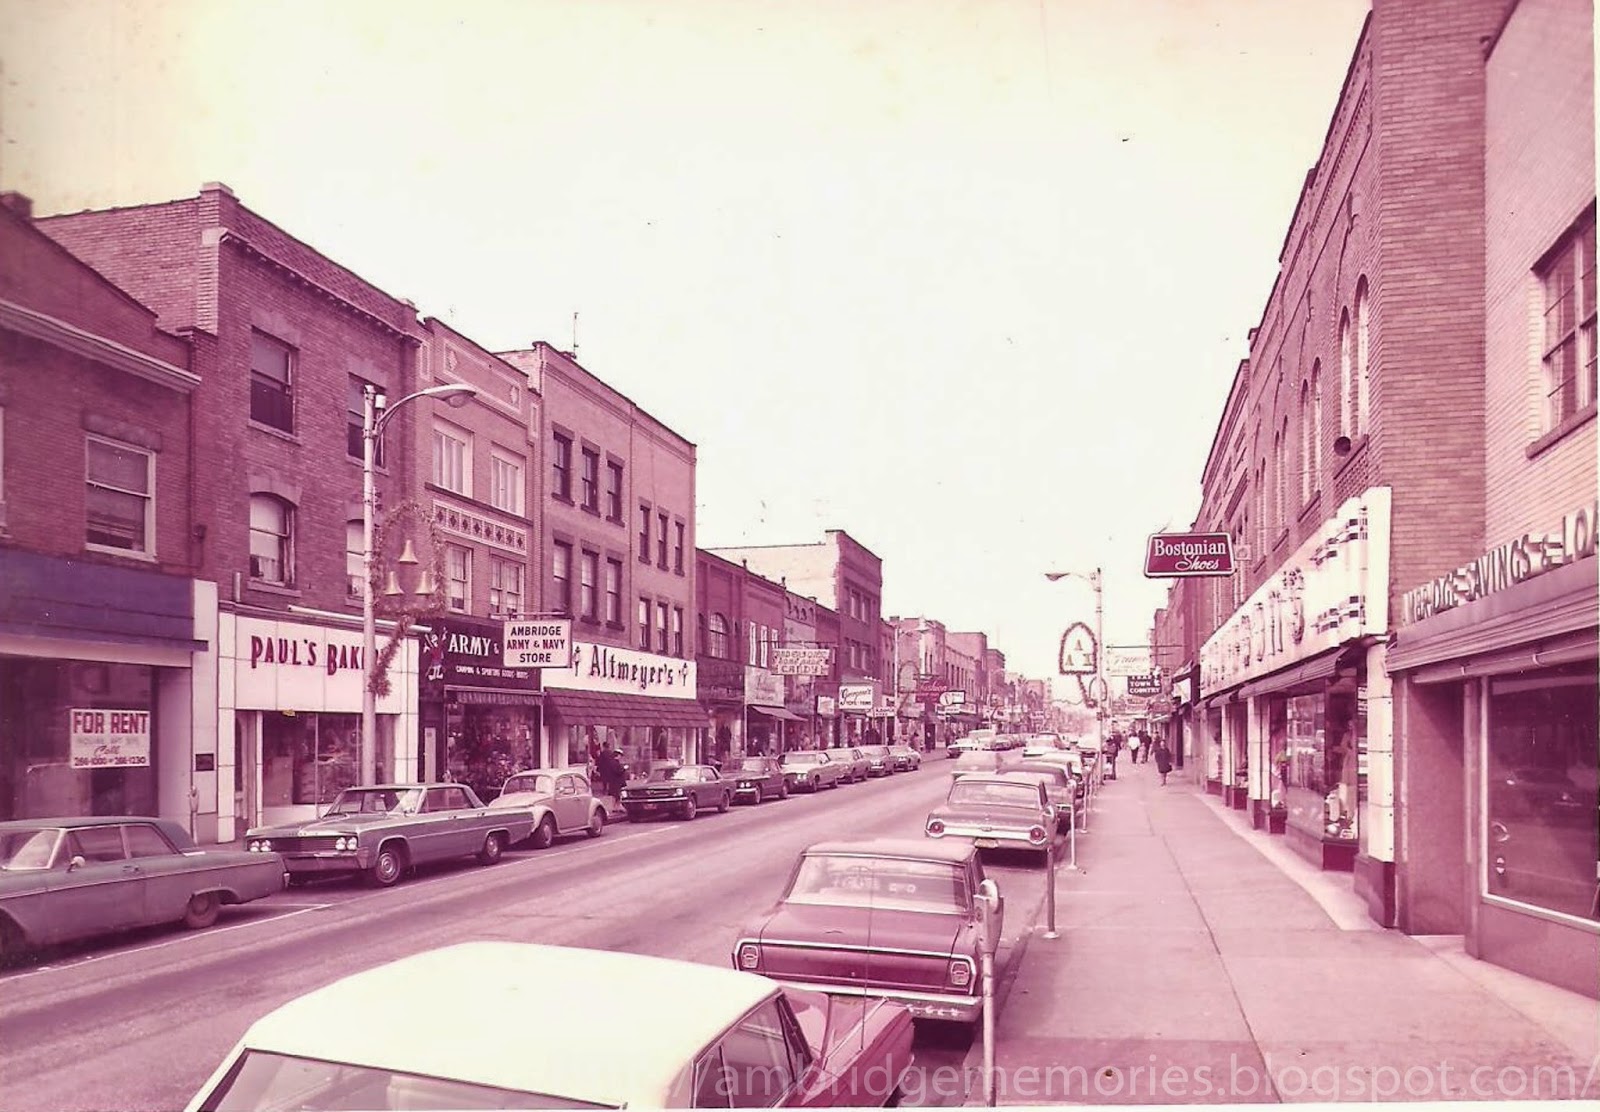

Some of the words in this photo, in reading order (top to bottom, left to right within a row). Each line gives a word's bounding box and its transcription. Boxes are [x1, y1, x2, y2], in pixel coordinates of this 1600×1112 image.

[1154, 539, 1227, 556] Bostonian
[1175, 553, 1219, 571] Shoes
[1466, 534, 1531, 602] SAVINGS
[510, 626, 562, 636] AMBRIDGE
[251, 635, 317, 669] PAUL'S
[447, 633, 492, 656] ARMY
[506, 639, 530, 650] ARMY
[533, 640, 540, 648] &
[542, 639, 566, 650] NAVY
[519, 653, 552, 663] STORE
[588, 645, 674, 690] Altmeyer's
[73, 711, 105, 734] FOR
[110, 711, 148, 734] RENT
